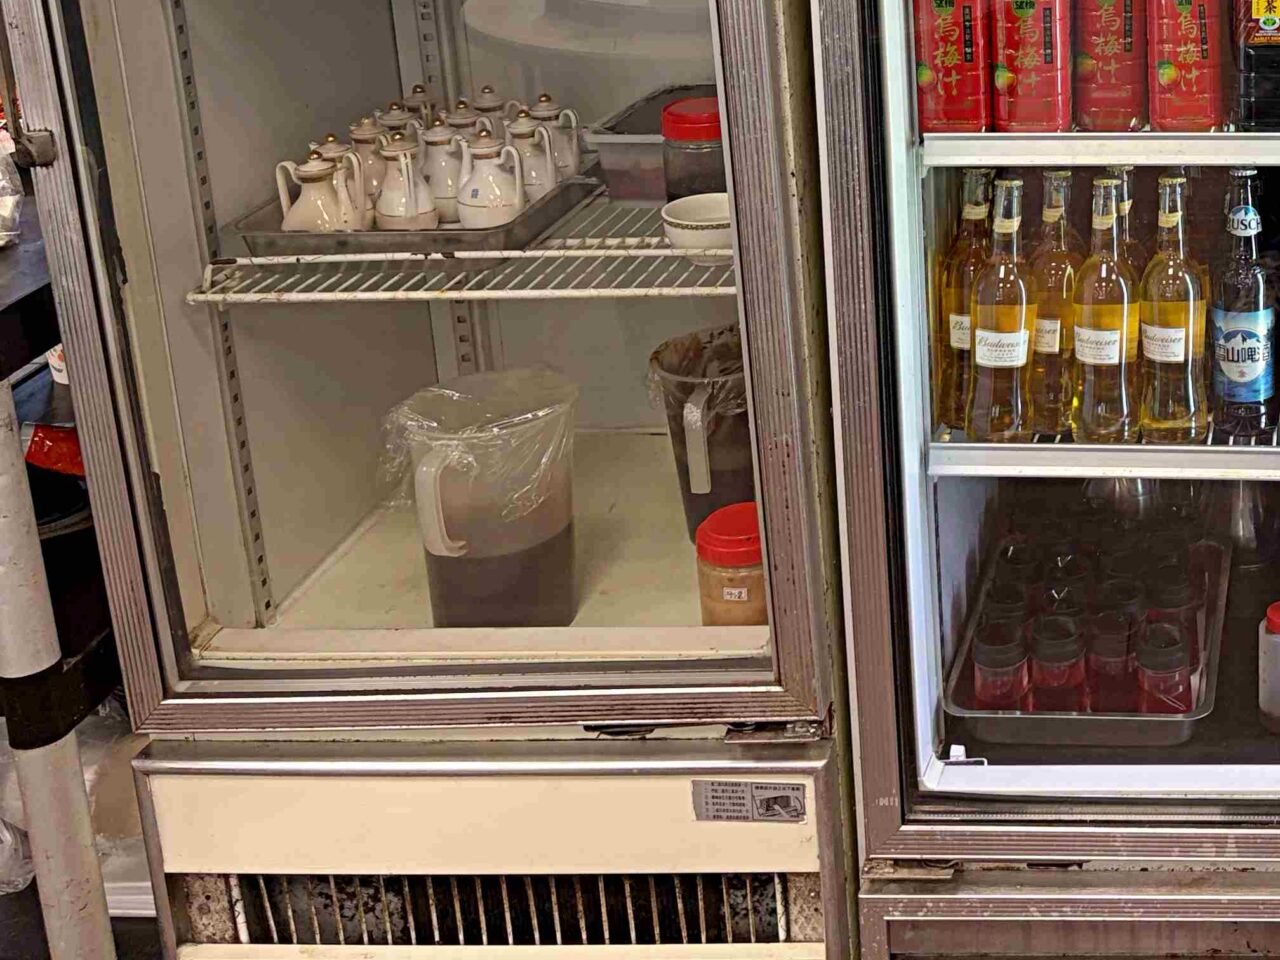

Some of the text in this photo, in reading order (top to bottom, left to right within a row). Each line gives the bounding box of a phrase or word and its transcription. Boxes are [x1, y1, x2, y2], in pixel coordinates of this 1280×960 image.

[934, 15, 962, 96] 烏梅汁
[1013, 17, 1041, 96] 烏梅汁
[1091, 4, 1121, 84] 烏梅汁
[1177, 12, 1201, 92] 烏梅汁
[1226, 215, 1262, 231] BUSCH
[1215, 343, 1271, 363] 雪山啤酒
